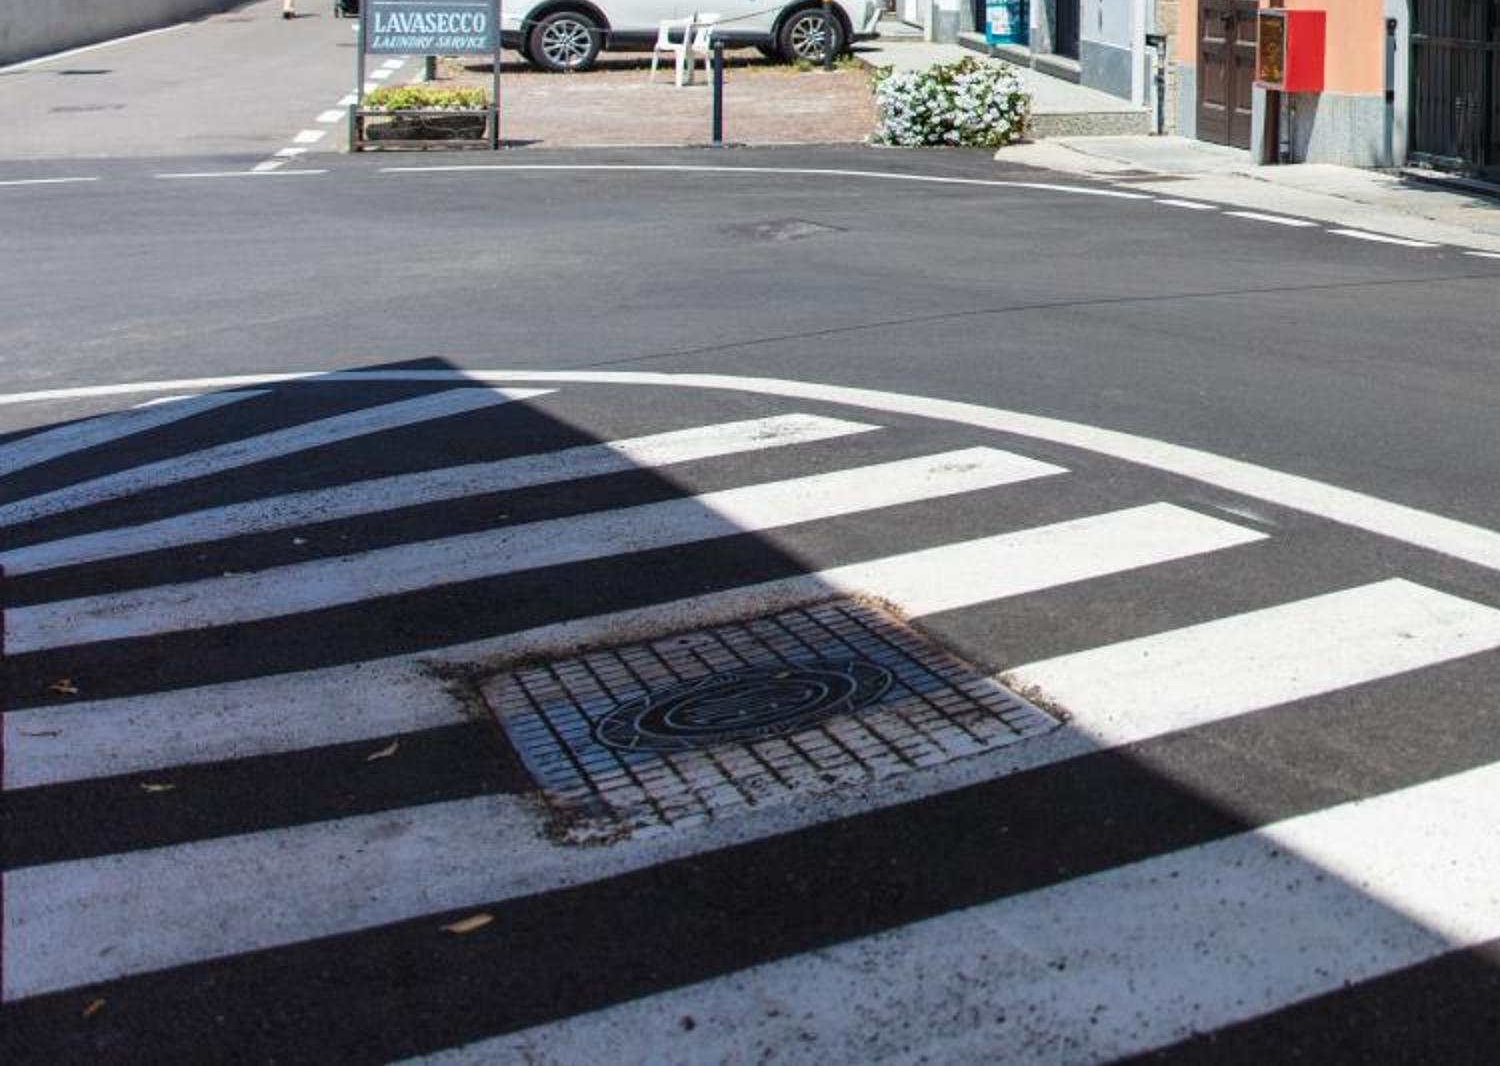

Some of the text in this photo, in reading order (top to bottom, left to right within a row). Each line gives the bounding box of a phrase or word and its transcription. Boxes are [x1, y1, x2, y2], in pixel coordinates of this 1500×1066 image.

[373, 11, 487, 34] LAVASECCO
[372, 35, 487, 49] LAUNDRY SERVICE
